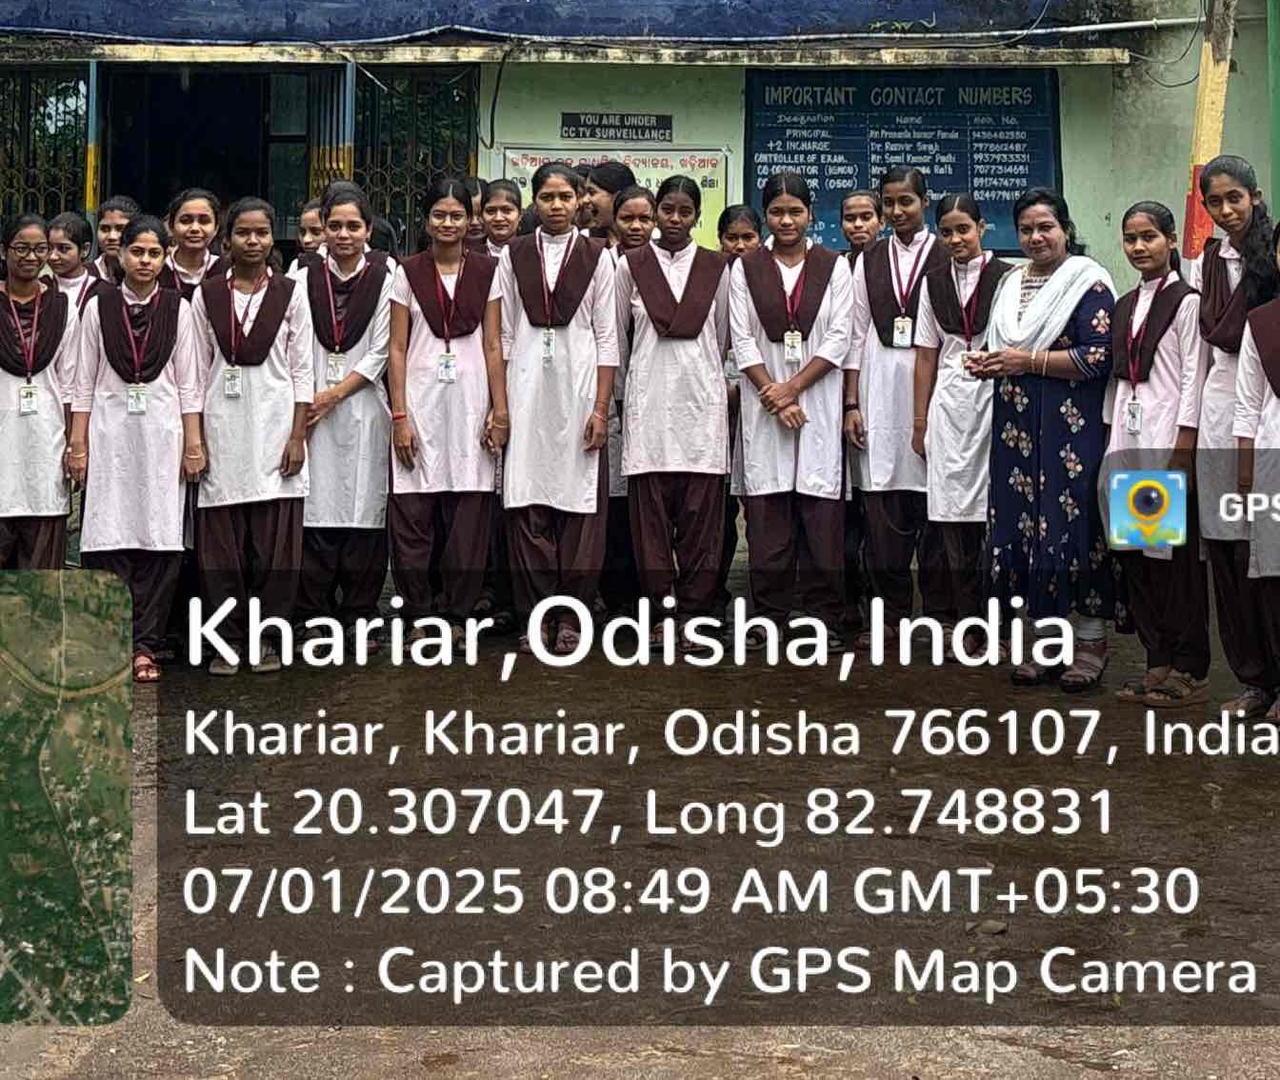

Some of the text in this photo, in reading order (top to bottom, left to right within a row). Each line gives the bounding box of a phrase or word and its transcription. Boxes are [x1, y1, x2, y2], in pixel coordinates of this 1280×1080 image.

[765, 87, 1033, 107] IMPORTANT CONTACT NUMBERS
[580, 115, 656, 126] YOU ARE UNDER
[595, 128, 670, 140] SURVEILLANCE
[786, 129, 831, 138] PRINCIPAL
[767, 140, 830, 151] +2 INCHARGE
[754, 152, 805, 163] CONTROLLER
[807, 153, 817, 162] OF
